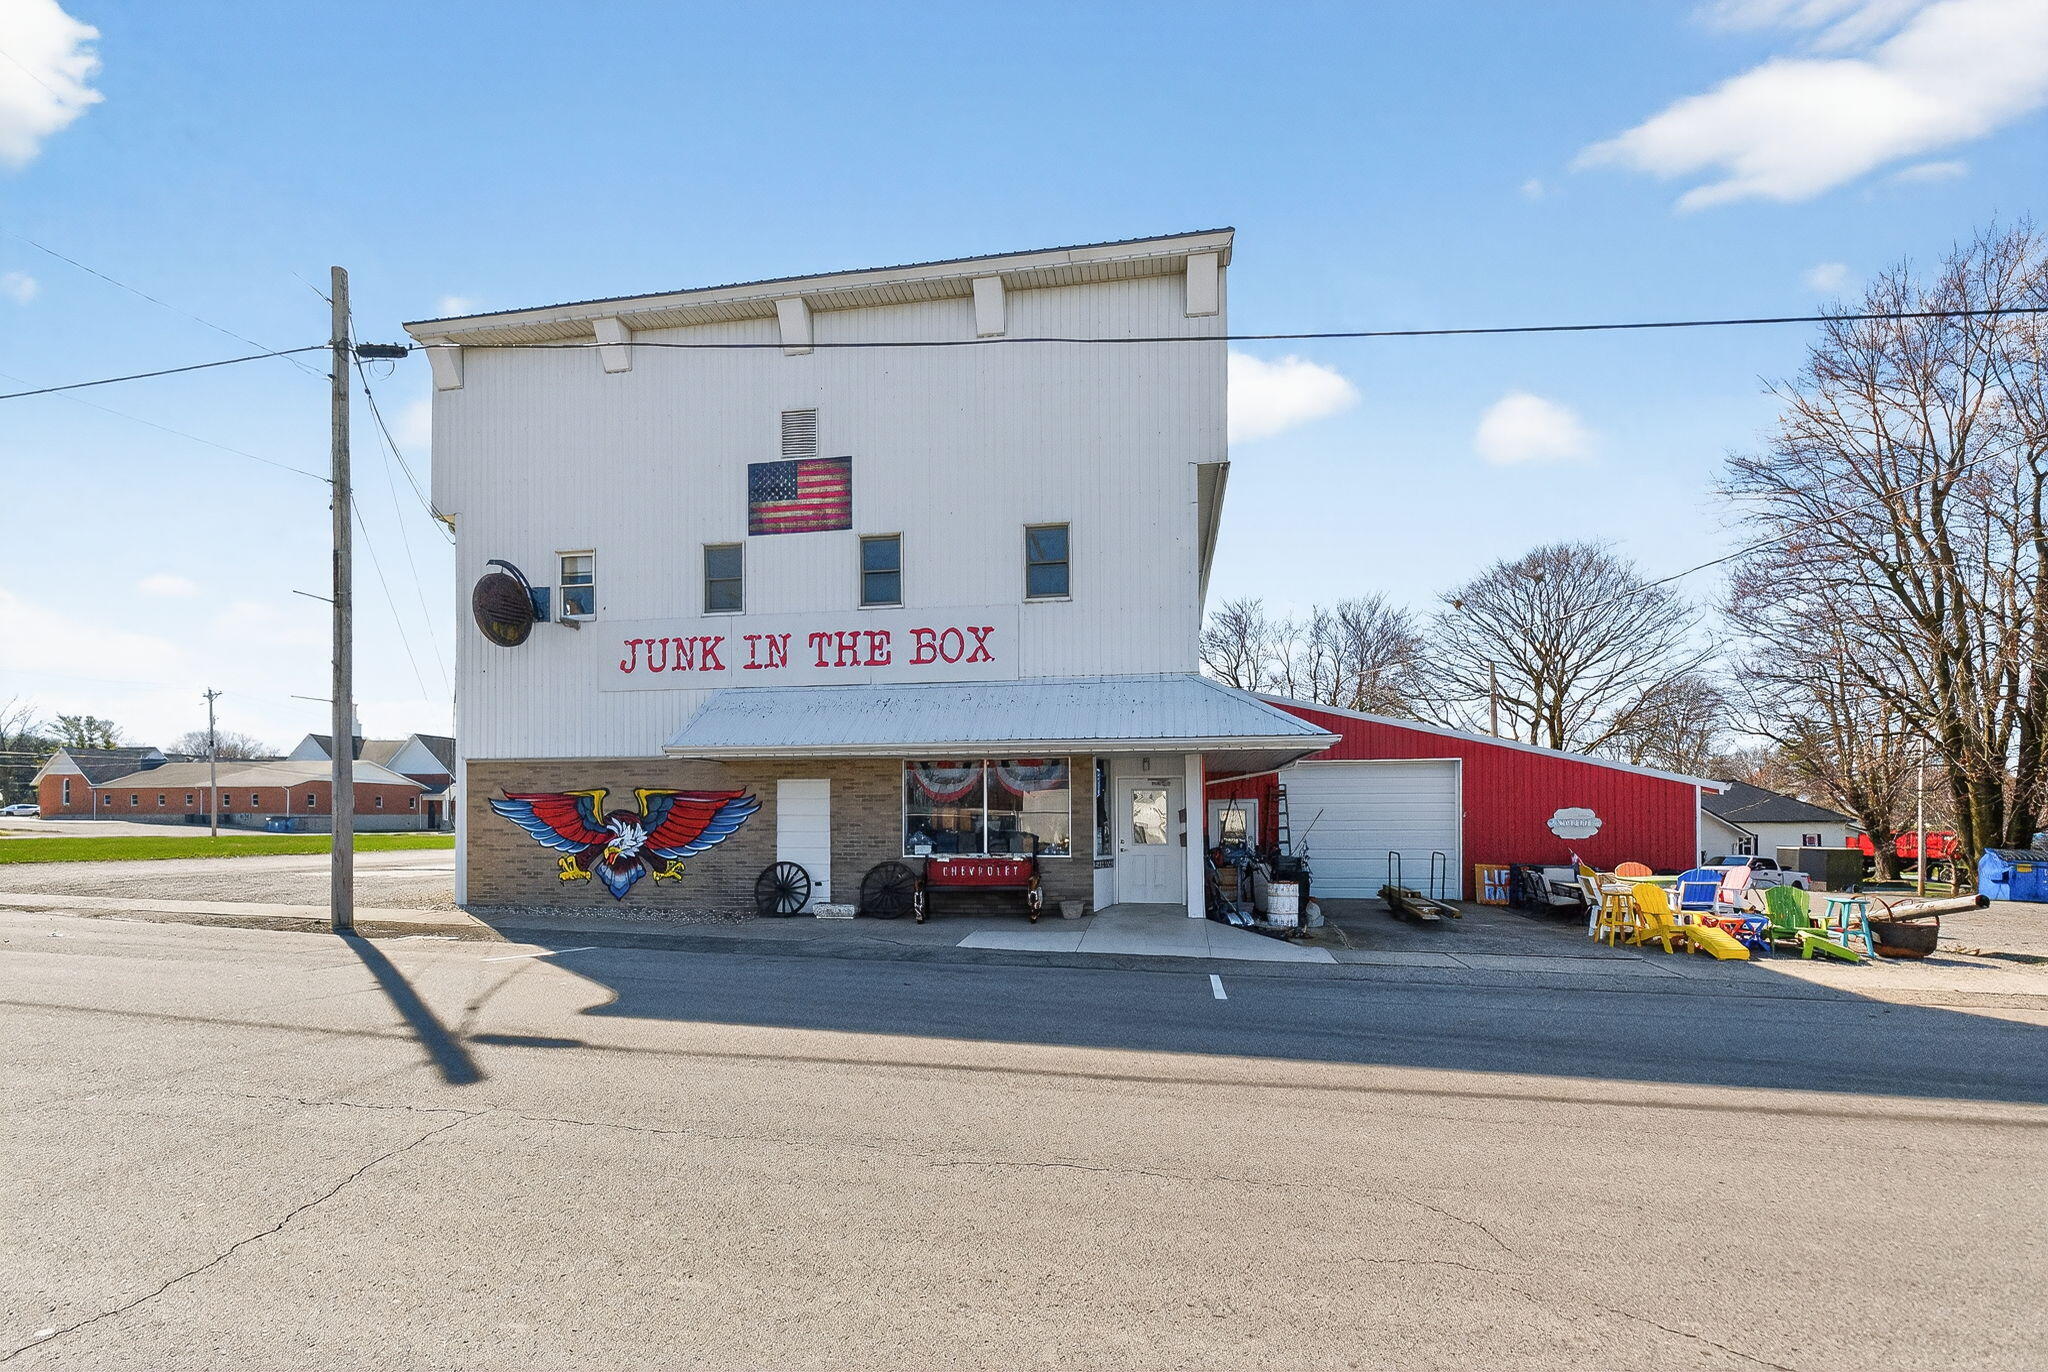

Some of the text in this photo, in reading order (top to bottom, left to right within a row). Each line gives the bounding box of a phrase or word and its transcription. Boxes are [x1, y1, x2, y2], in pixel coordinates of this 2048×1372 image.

[619, 626, 996, 674] JUNK IN THE BOX
[942, 865, 1019, 877] CHEVROLET
